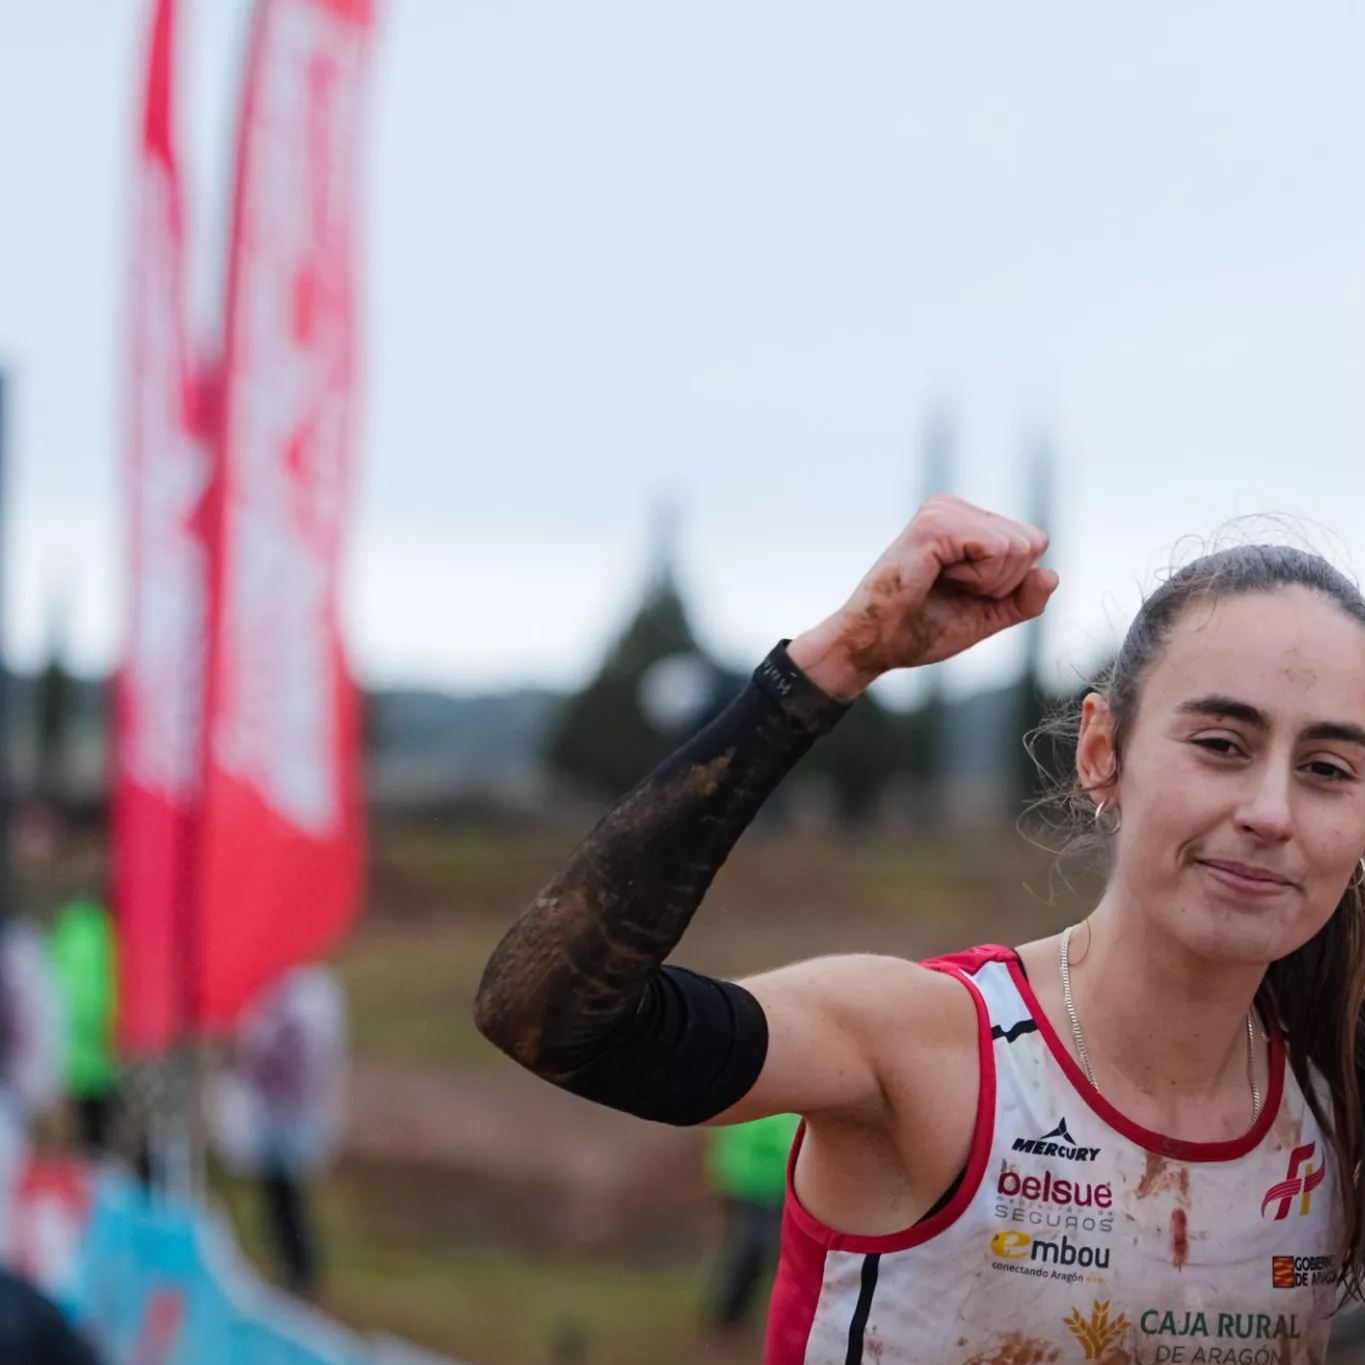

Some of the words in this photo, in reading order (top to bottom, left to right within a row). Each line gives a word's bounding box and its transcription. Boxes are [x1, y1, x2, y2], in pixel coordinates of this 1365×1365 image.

[1011, 1138, 1101, 1161] MERCURY
[995, 1204, 1113, 1232] SEGUROS
[990, 1230, 1110, 1268] embou
[992, 1261, 1048, 1278] conectando
[1050, 1270, 1084, 1283] Aragón
[1295, 1272, 1308, 1287] DE
[1140, 1309, 1209, 1337] CAJA
[1217, 1312, 1300, 1339] RURAL
[1155, 1345, 1186, 1364] DE
